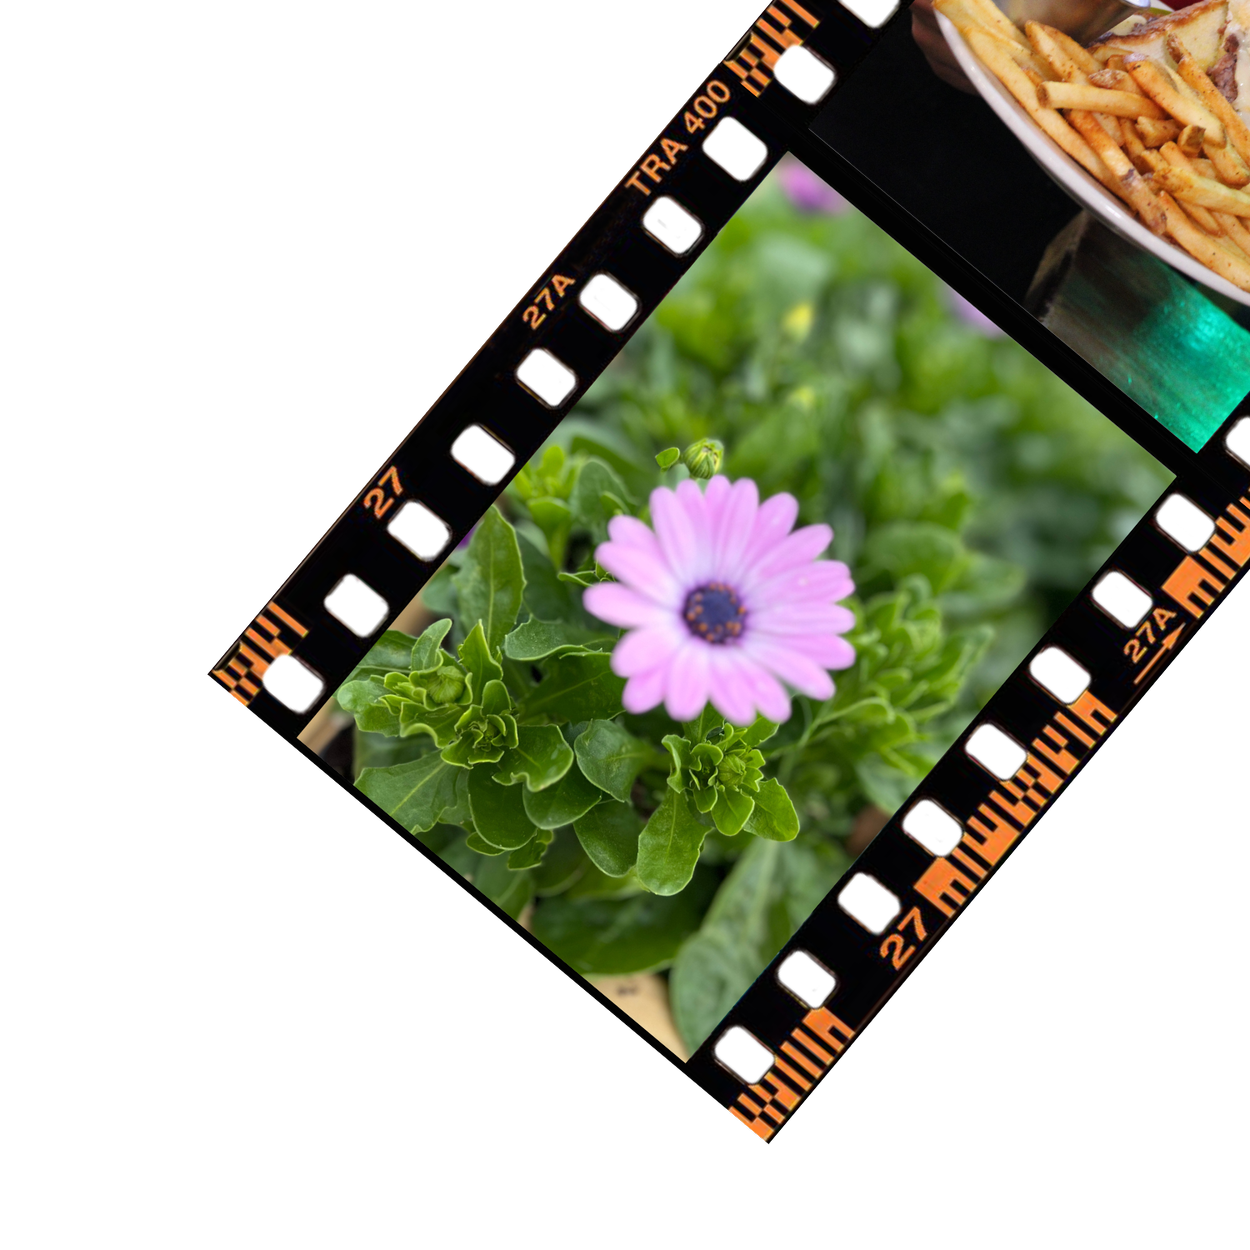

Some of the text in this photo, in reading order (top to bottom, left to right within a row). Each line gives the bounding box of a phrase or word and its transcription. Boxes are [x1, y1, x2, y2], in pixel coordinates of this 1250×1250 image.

[624, 79, 731, 196] TRA 400
[521, 273, 576, 330] 27A
[362, 465, 404, 519] 27
[1122, 607, 1178, 664] 27A
[879, 906, 928, 971] 27
